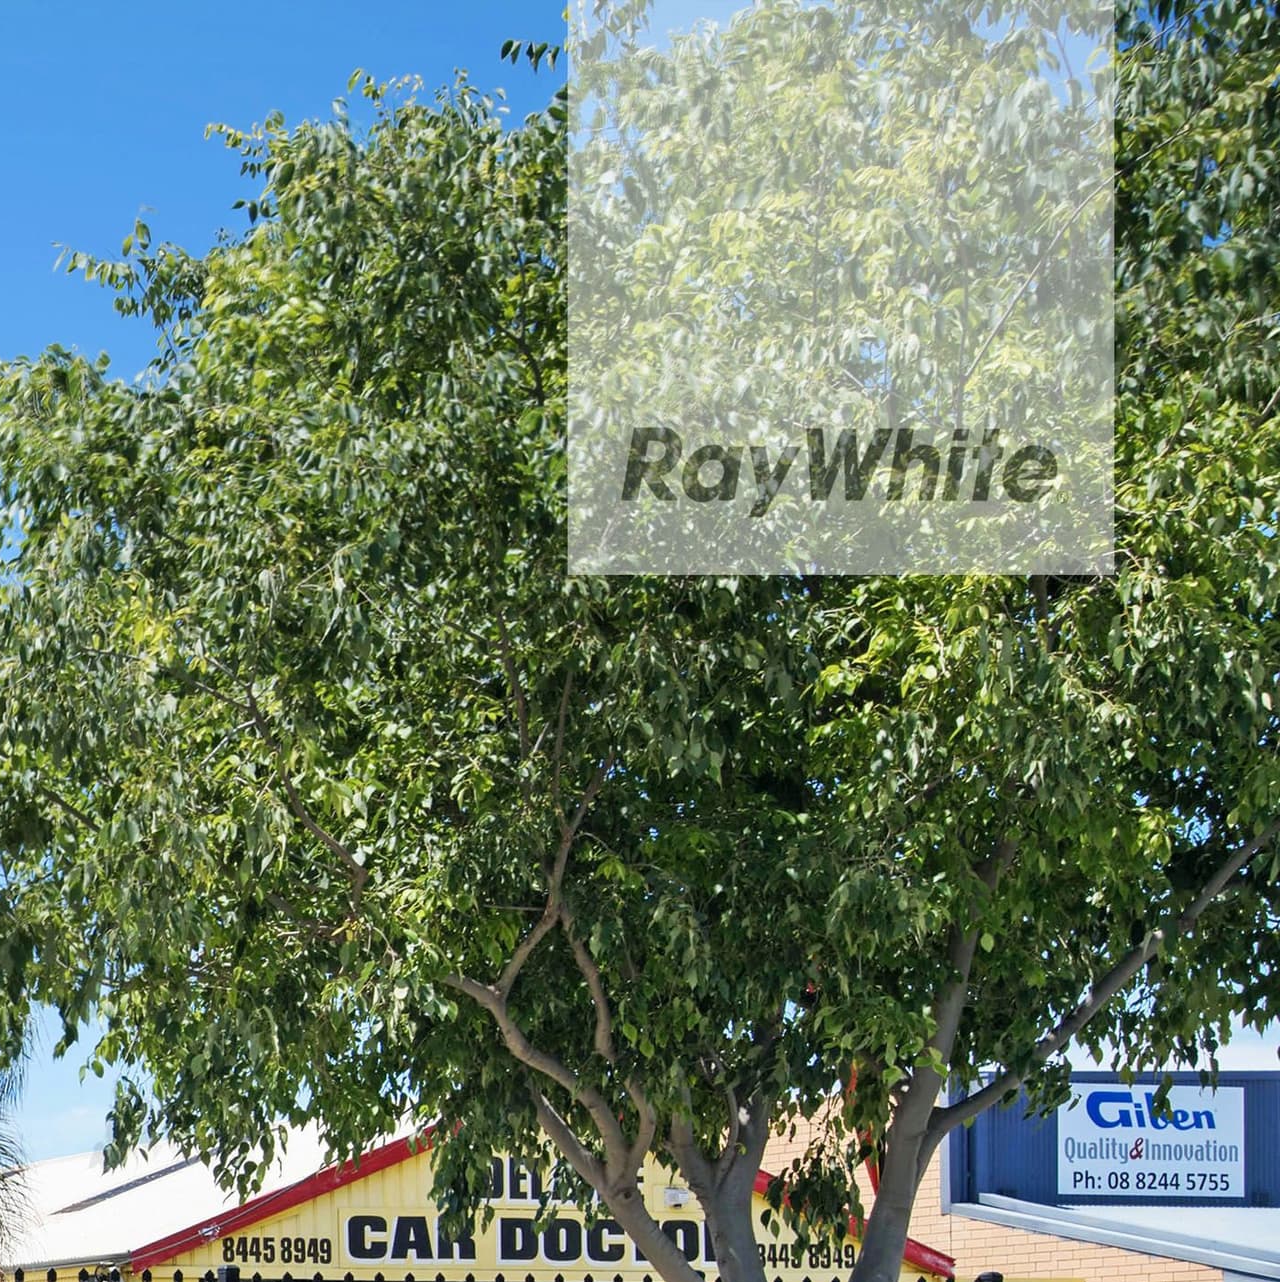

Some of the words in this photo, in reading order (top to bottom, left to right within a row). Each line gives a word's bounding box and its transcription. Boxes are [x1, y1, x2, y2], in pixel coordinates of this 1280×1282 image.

[1073, 1170, 1102, 1189] Ph:
[1108, 1171, 1130, 1189] 08
[1135, 1172, 1180, 1190] 8244
[1186, 1172, 1230, 1191] 5755
[222, 1235, 275, 1264] 8445
[280, 1236, 333, 1266] 8949
